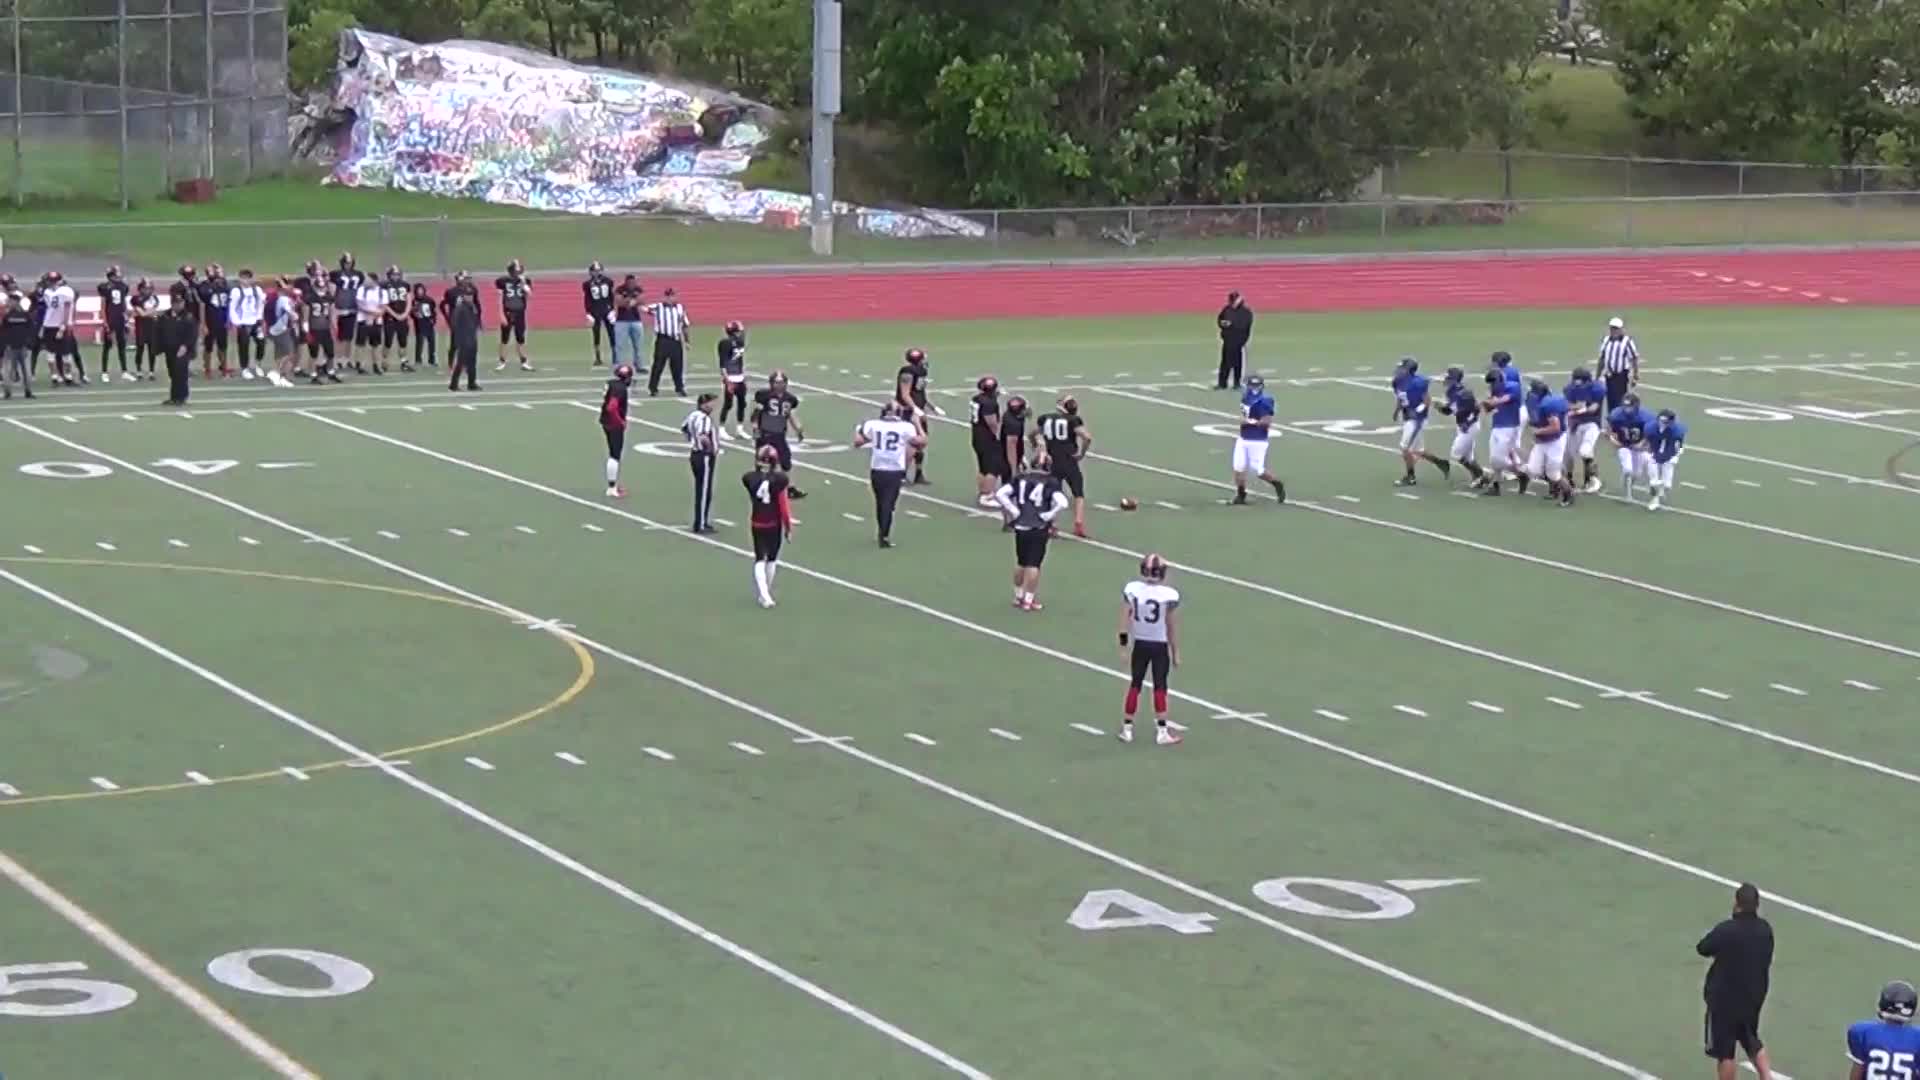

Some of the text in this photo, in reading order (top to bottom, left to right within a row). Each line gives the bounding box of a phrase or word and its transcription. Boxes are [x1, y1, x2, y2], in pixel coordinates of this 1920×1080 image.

[110, 288, 122, 305] 9
[874, 430, 900, 452] 12
[1041, 417, 1069, 441] 40
[755, 478, 771, 505] 4
[1018, 479, 1045, 507] 14
[1132, 596, 1161, 624] 13
[1866, 1048, 1915, 1080] 25
